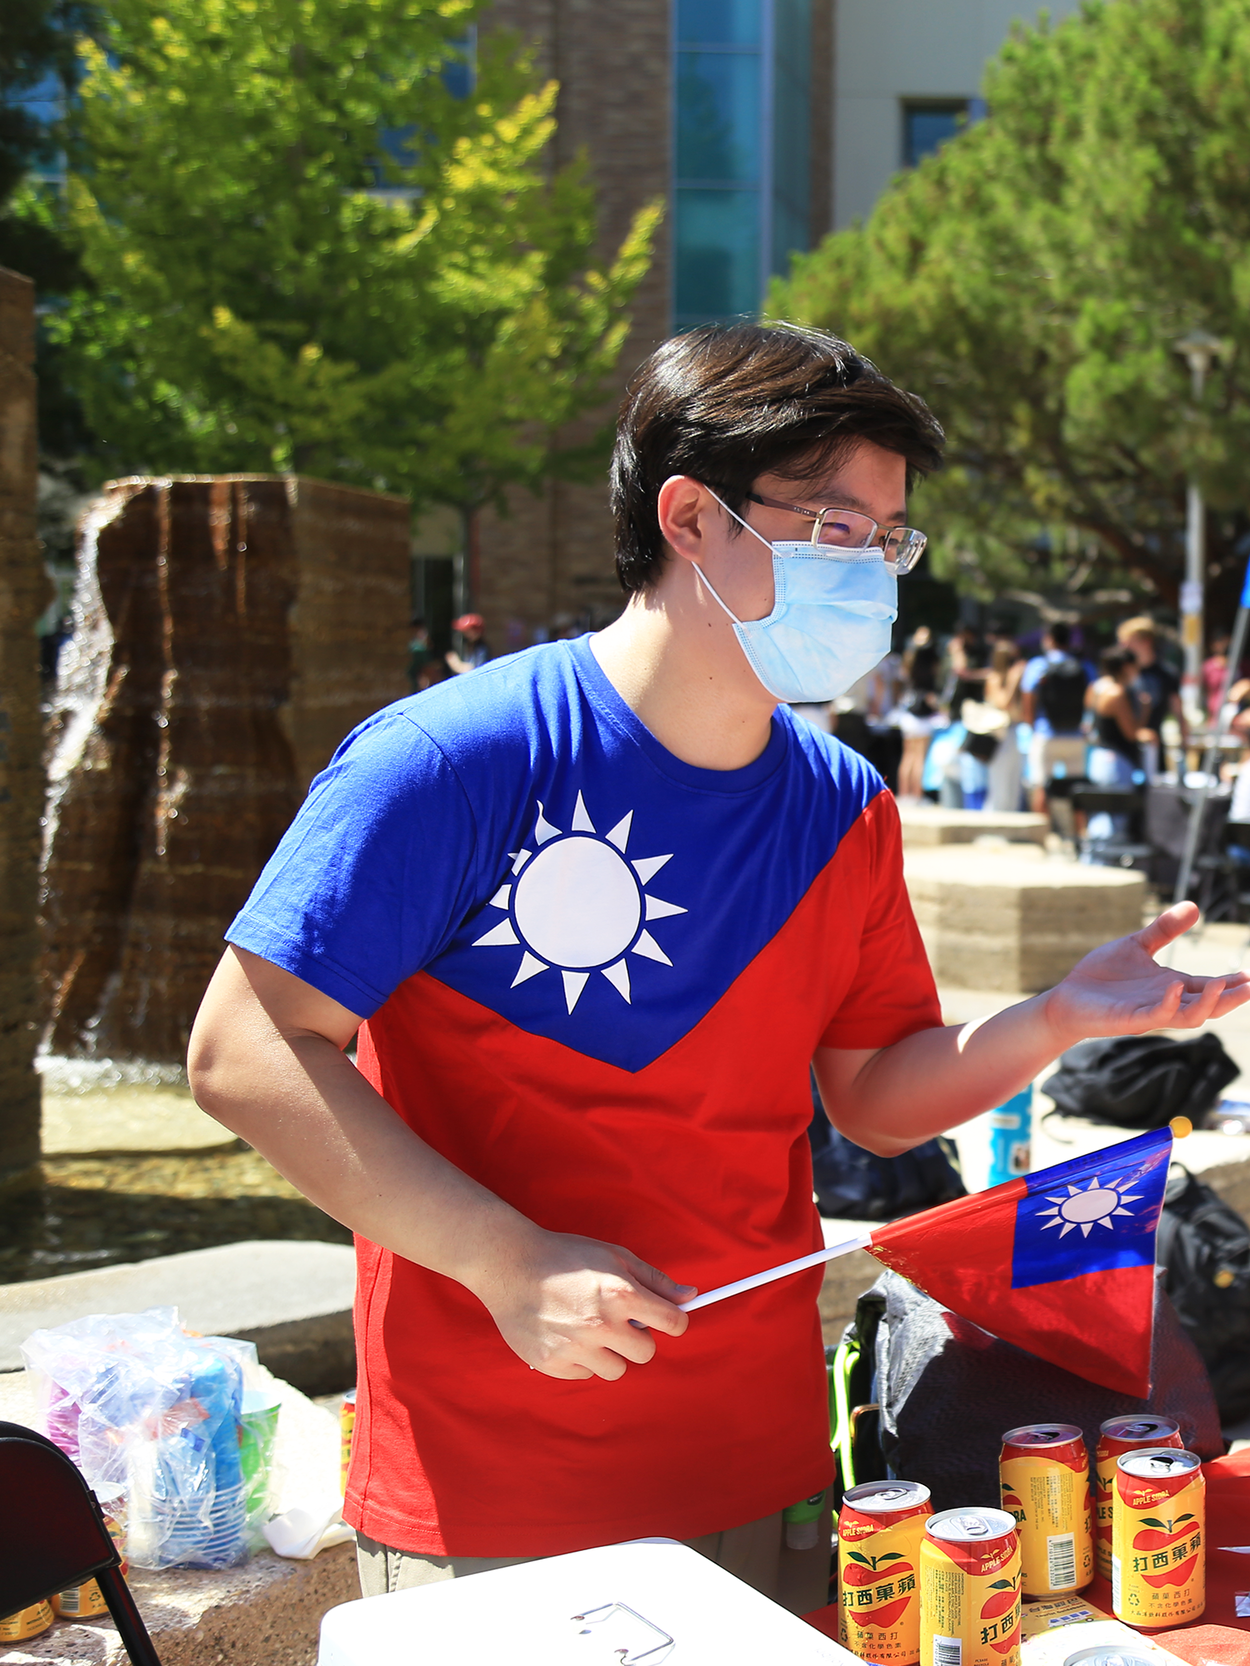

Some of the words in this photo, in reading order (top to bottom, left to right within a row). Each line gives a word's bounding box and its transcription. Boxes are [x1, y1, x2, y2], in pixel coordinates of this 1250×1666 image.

[1132, 1495, 1151, 1506] APPLE
[842, 1527, 856, 1537] APPLE
[980, 1555, 1001, 1573] APPLE
